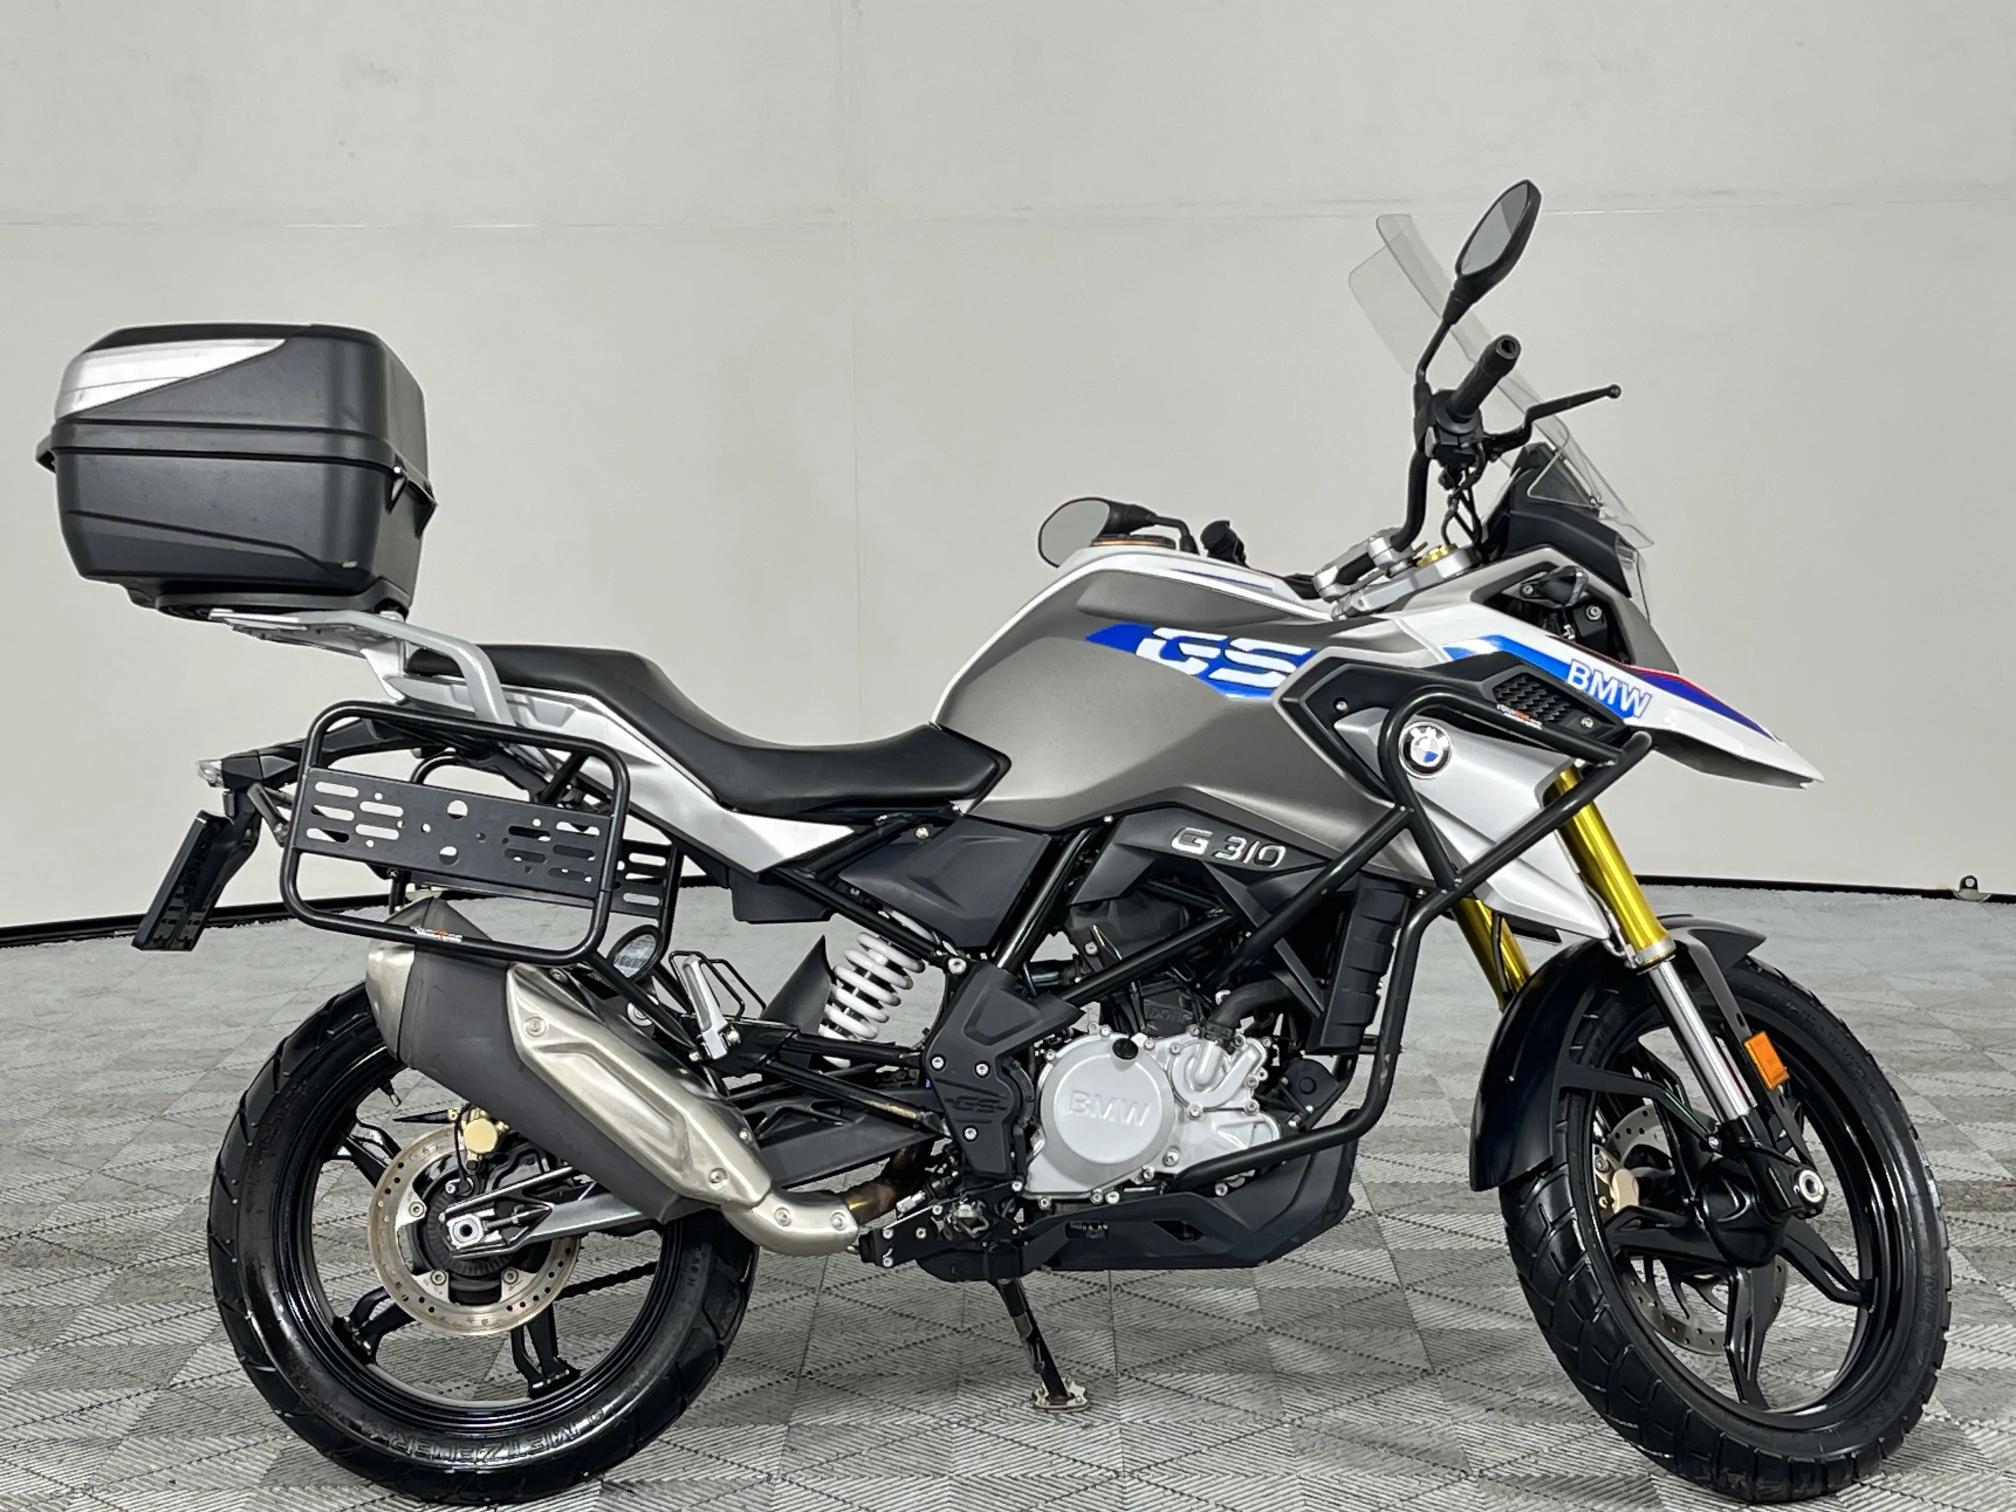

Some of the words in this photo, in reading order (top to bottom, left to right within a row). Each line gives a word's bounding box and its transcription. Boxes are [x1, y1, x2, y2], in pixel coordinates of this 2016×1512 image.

[1136, 626, 1312, 688] GS
[1566, 658, 1652, 719] BMW
[1171, 827, 1213, 855] G
[1214, 836, 1286, 868] 310
[1068, 1090, 1152, 1127] BMW
